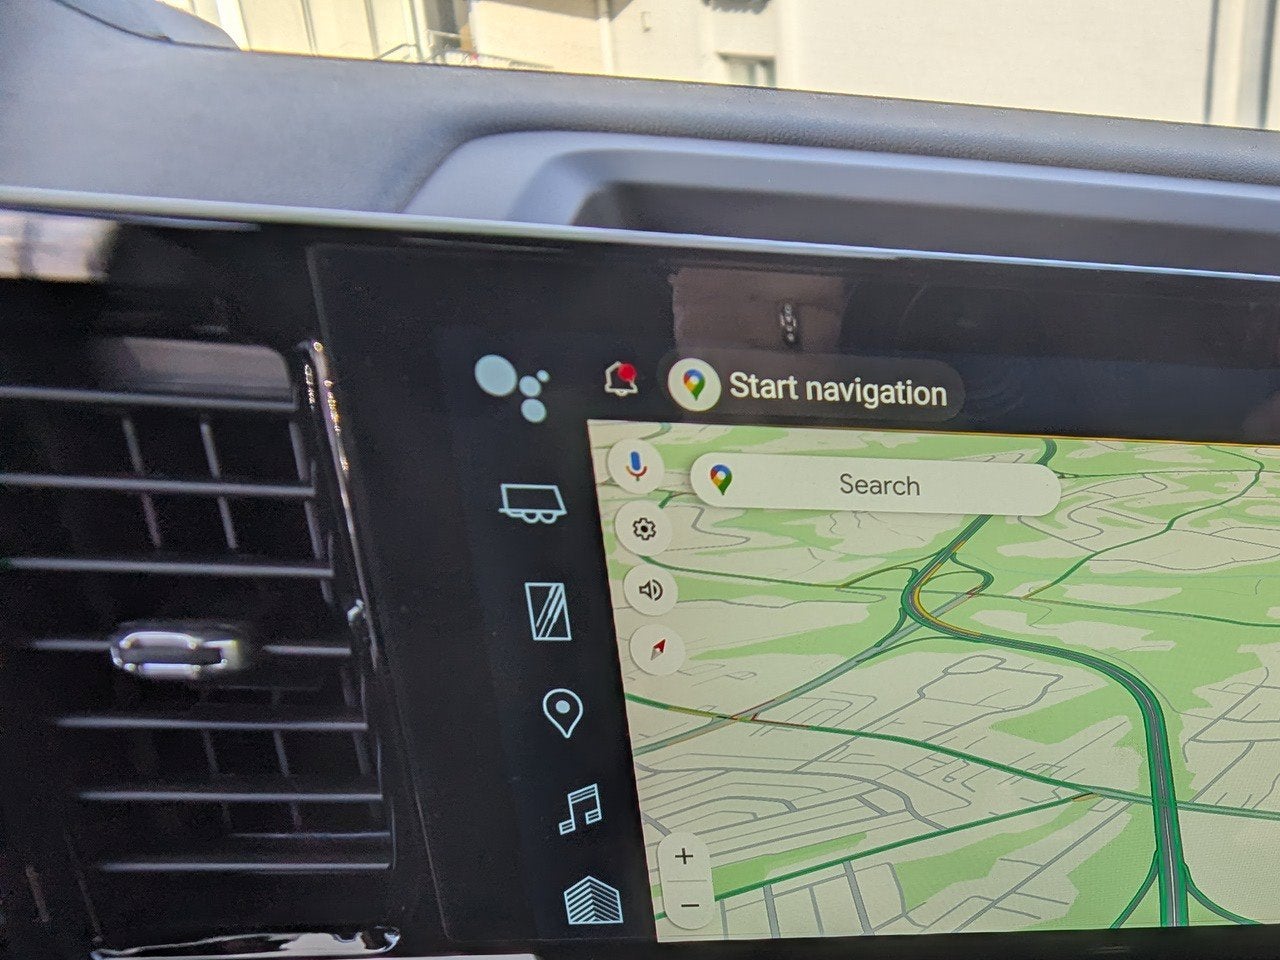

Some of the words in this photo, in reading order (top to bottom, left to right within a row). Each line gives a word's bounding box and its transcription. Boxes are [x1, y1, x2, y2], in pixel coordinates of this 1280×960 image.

[729, 370, 798, 403] Start
[805, 376, 948, 408] navigation
[839, 472, 921, 498] Search
